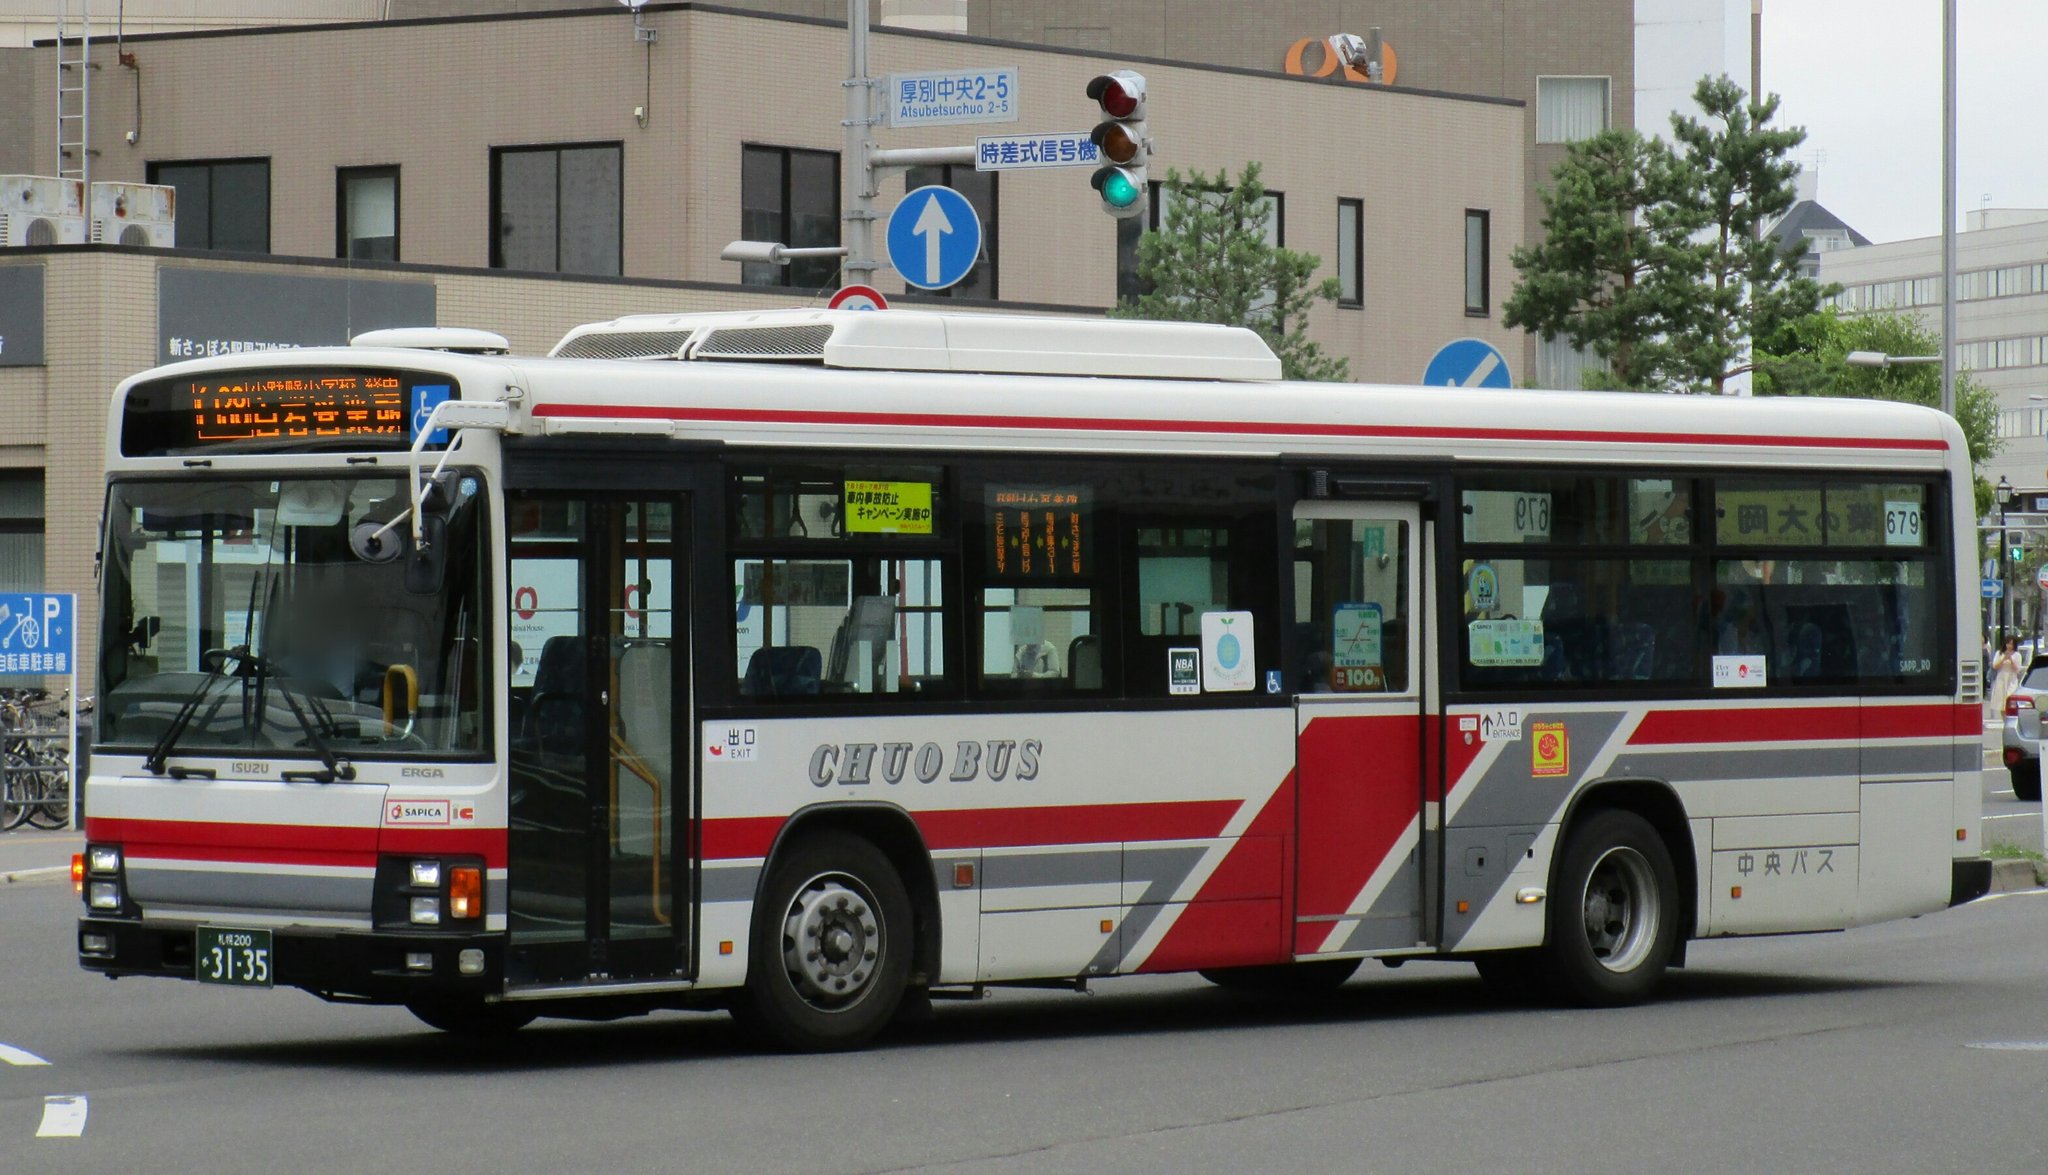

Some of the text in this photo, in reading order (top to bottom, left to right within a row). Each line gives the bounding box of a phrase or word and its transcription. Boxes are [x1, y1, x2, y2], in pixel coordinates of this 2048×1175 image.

[900, 75, 1008, 103] 厚別中央2-5
[900, 101, 1008, 118] Atsubetsuchuo 2-5
[981, 138, 1098, 164] 時差式信号機
[847, 491, 899, 505] 車内事故防止
[857, 506, 930, 521] キャンペーン実施中
[1886, 510, 1919, 535] 679
[44, 597, 60, 648] P
[1175, 658, 1193, 669] NBA
[1496, 711, 1518, 726] 入口
[728, 728, 755, 745] 出口
[1492, 728, 1520, 739] ENTRANCE
[731, 748, 751, 758] EXIT
[232, 762, 269, 774] ISUZU
[808, 738, 1043, 788] CHUO BUS
[401, 767, 444, 779] ERGA
[405, 808, 441, 817] SAPICA
[1738, 849, 1834, 877] 中央バス
